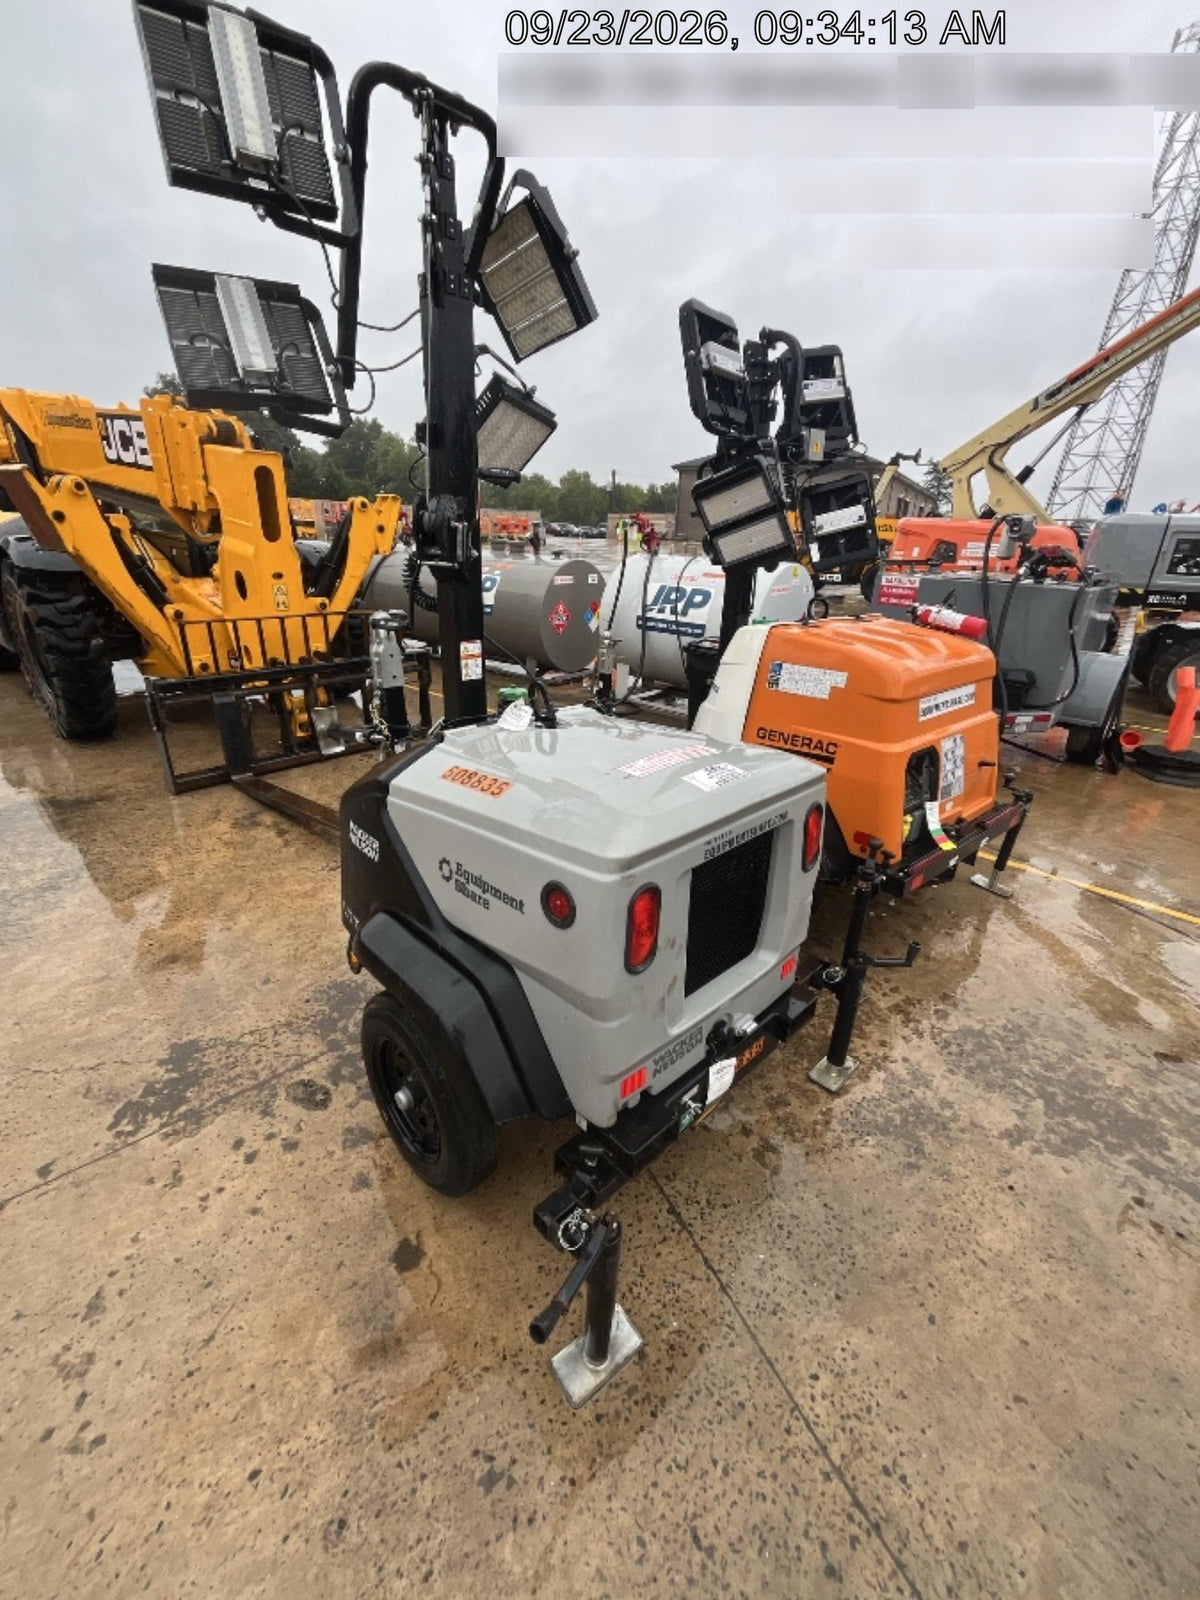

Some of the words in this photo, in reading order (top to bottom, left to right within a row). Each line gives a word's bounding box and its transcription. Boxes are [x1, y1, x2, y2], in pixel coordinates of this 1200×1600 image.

[756, 726, 839, 755] GENERAC
[455, 862, 525, 914] Equipment
[455, 878, 490, 910] Share
